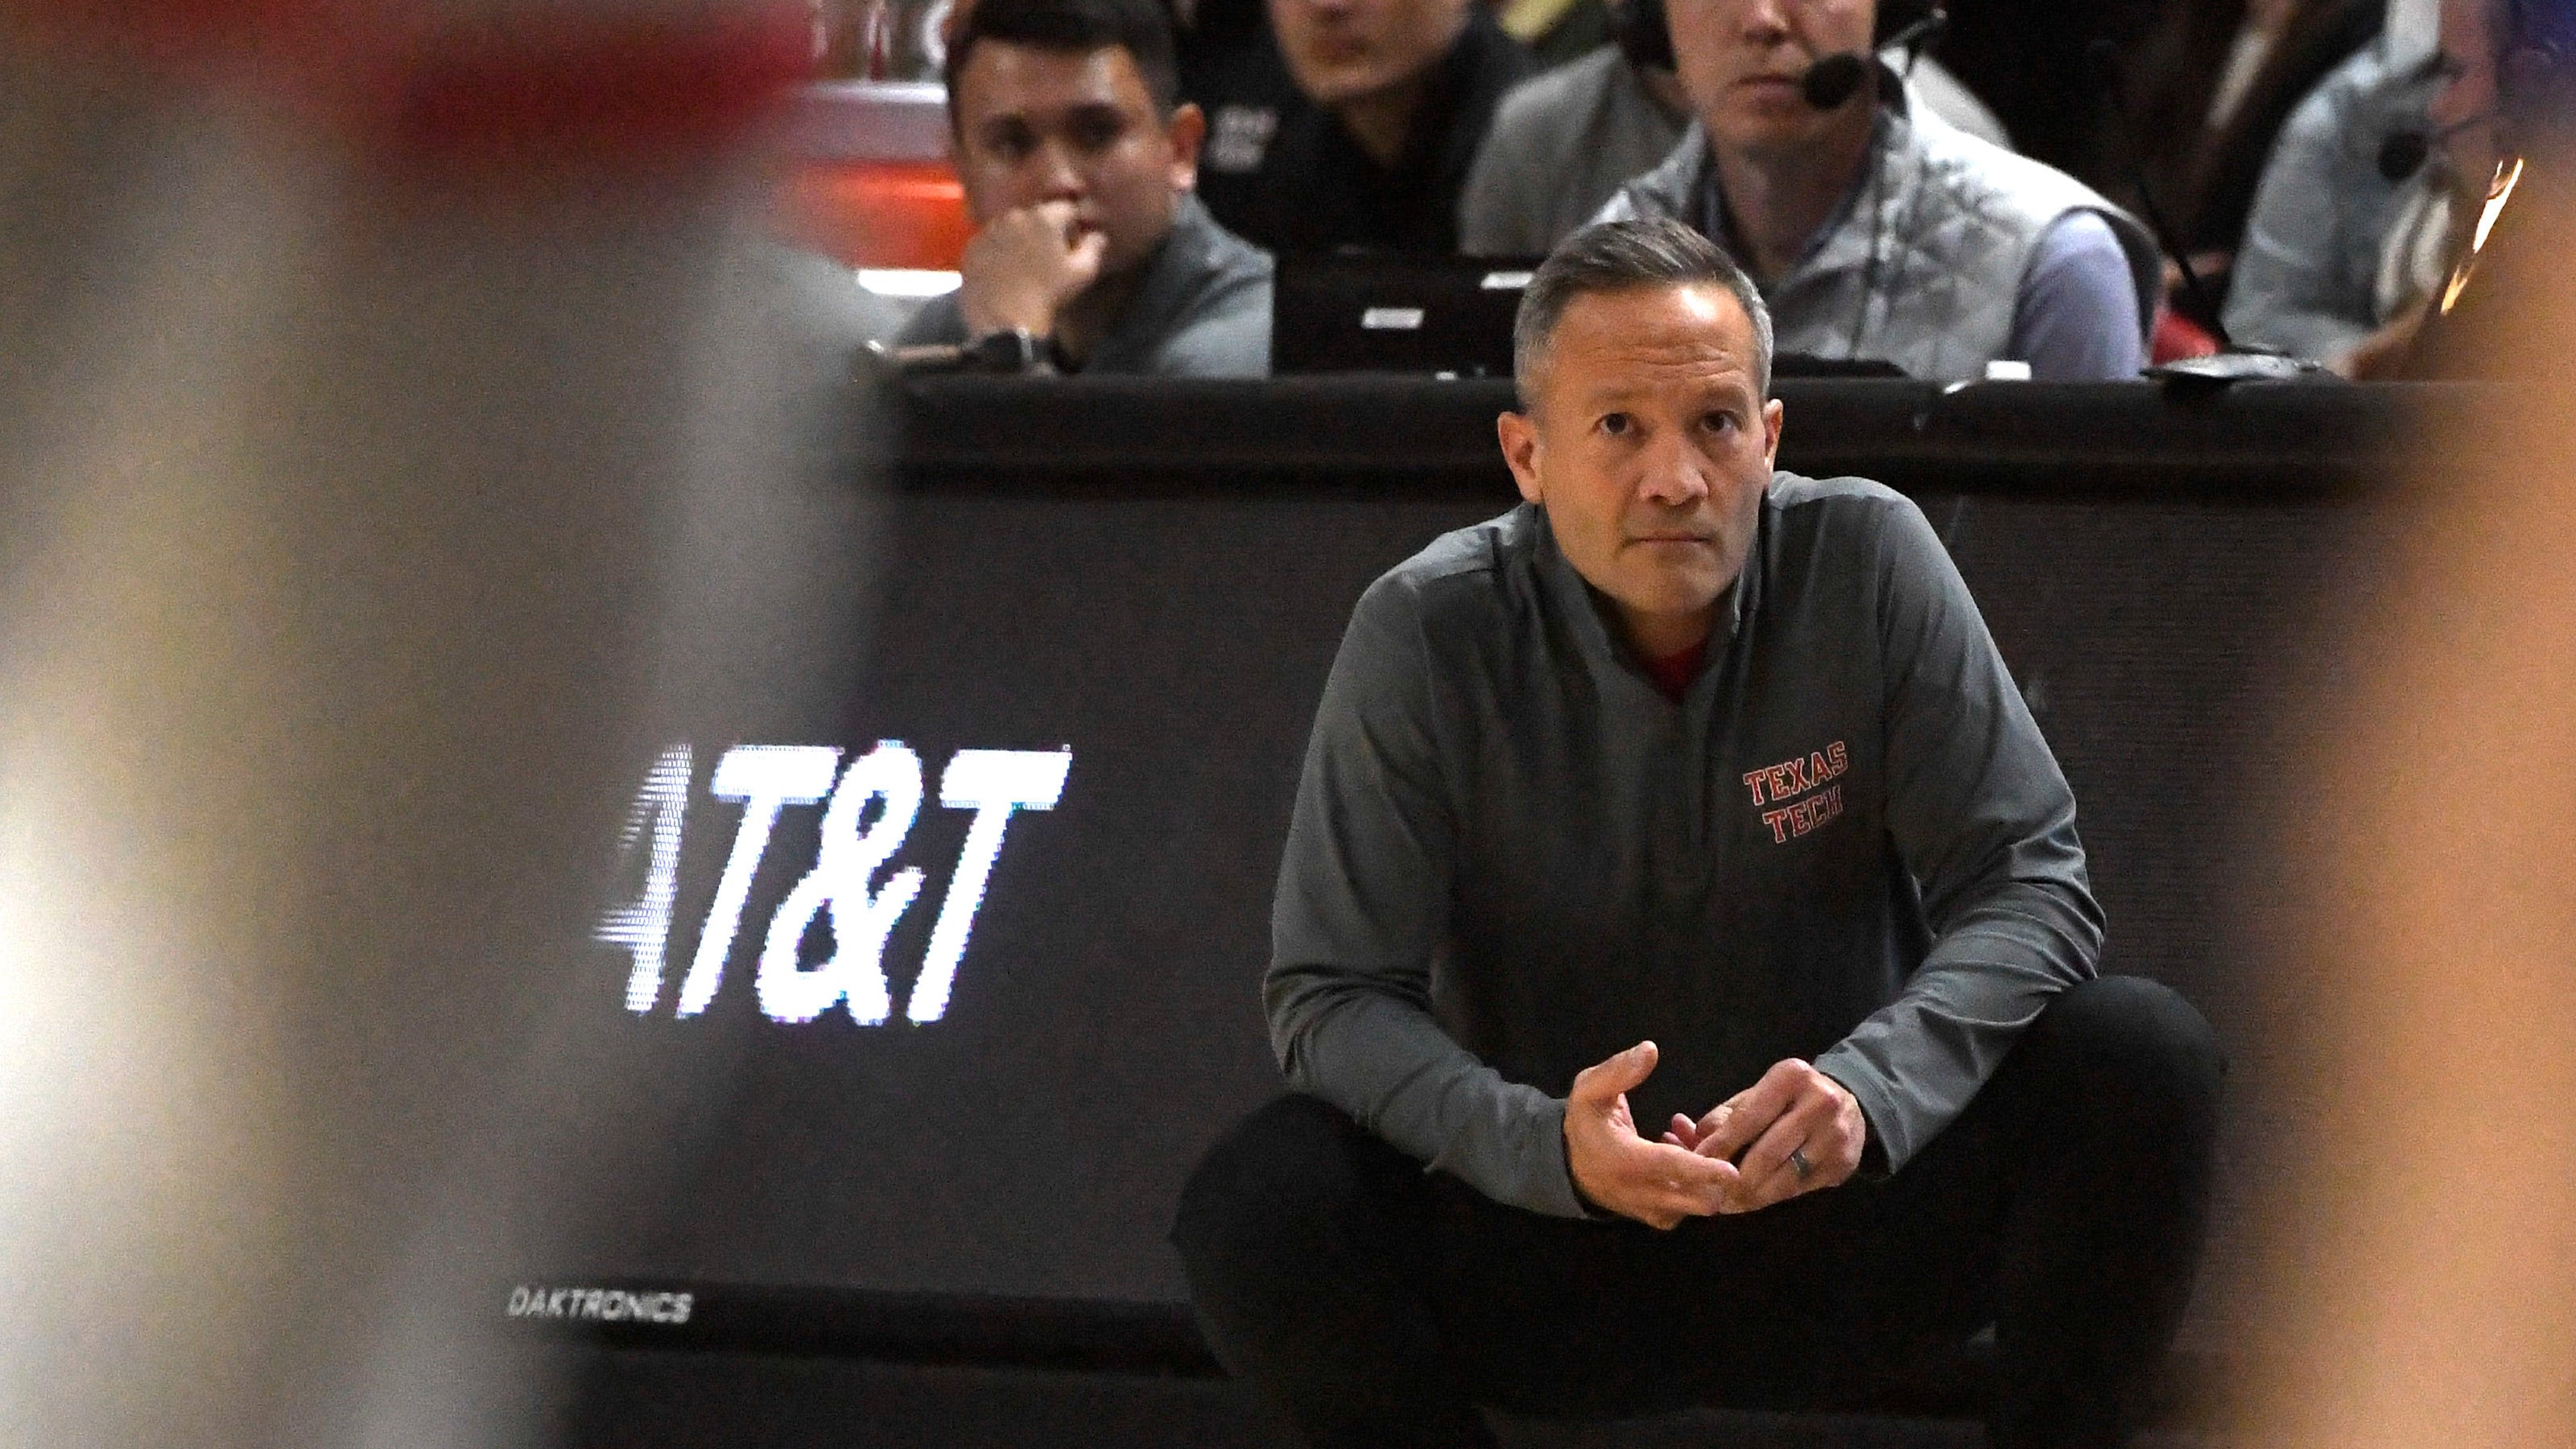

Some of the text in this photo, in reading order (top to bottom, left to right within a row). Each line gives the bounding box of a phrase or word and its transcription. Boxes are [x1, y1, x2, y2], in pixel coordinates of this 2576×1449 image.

[1743, 741, 1848, 807] TEXAS
[1762, 785, 1843, 844] TECH
[508, 1286, 694, 1323] DAKTRONICS
